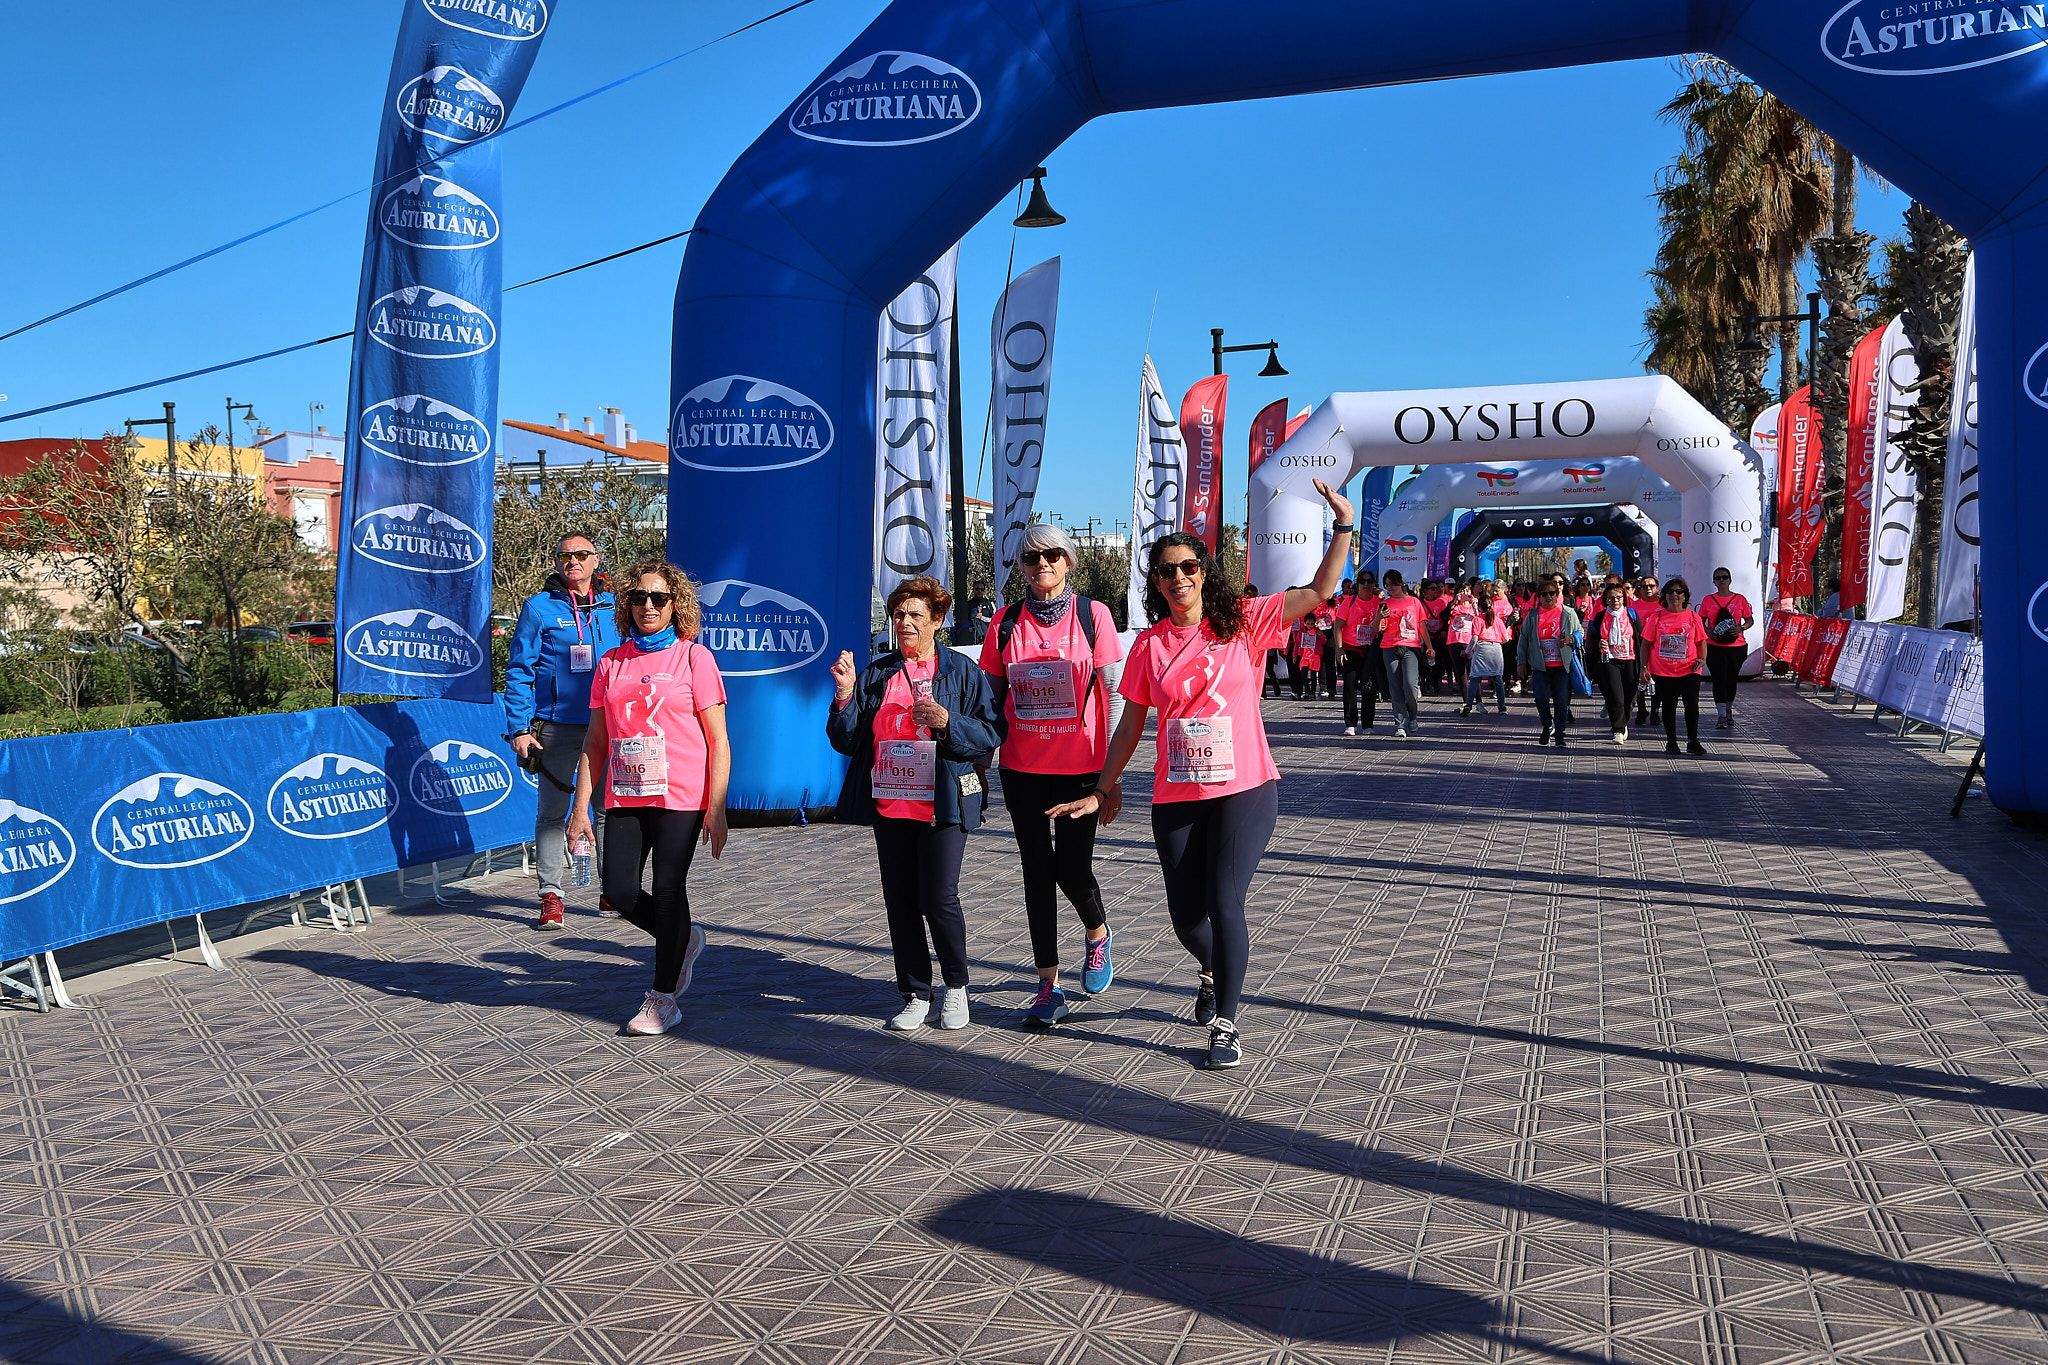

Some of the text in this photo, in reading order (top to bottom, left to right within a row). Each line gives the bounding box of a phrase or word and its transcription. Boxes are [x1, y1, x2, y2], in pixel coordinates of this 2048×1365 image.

[1841, 3, 2048, 59] ASTURIAN
[829, 79, 959, 97] CENTRAL LECHERA
[402, 87, 495, 134] ASTURIANA
[798, 94, 966, 127] ASTURIANA
[437, 202, 486, 217] LECHERA
[385, 199, 491, 239] ASTURIANA
[373, 306, 486, 346] ASTURIANA
[431, 312, 482, 324] LECHERA
[691, 408, 816, 421] CENTRAL LECHERA
[1394, 398, 1595, 444] OYSHO
[429, 420, 476, 432] LECHERA
[674, 413, 821, 450] ASTURIANA
[882, 273, 942, 575] OYSHO
[365, 414, 480, 453] ASTURIANA
[1656, 436, 1720, 452] OYSHO
[1194, 405, 1215, 508] Santander
[1280, 455, 1337, 468] OYSHO
[1562, 485, 1606, 494] TotalEnergies
[384, 523, 428, 534] CENTRAL
[1502, 516, 1595, 528] VOLVO
[1693, 519, 1752, 535] OYSHO
[359, 522, 475, 562] ASTURIANA
[1255, 532, 1307, 546] OYSHO
[1855, 513, 1871, 585] Sports
[700, 612, 810, 625] NTRAL LECHERA
[380, 629, 428, 640] CENTRAL
[697, 625, 815, 653] TURIANA
[355, 629, 473, 667] ASTURIANA
[1032, 686, 1056, 697] 016
[1039, 725, 1048, 733] DE
[1048, 725, 1056, 734] LA
[1186, 746, 1213, 758] 016
[464, 761, 498, 772] LECHERA
[625, 763, 646, 774] 016
[892, 766, 916, 778] 016
[297, 776, 382, 796] CENTRAL LECHERA
[420, 770, 508, 802] ASTURIANA
[127, 797, 233, 821] CENTRAL LECHERA
[281, 787, 393, 825] ASTURIANA
[111, 810, 247, 854] ASTURIANA
